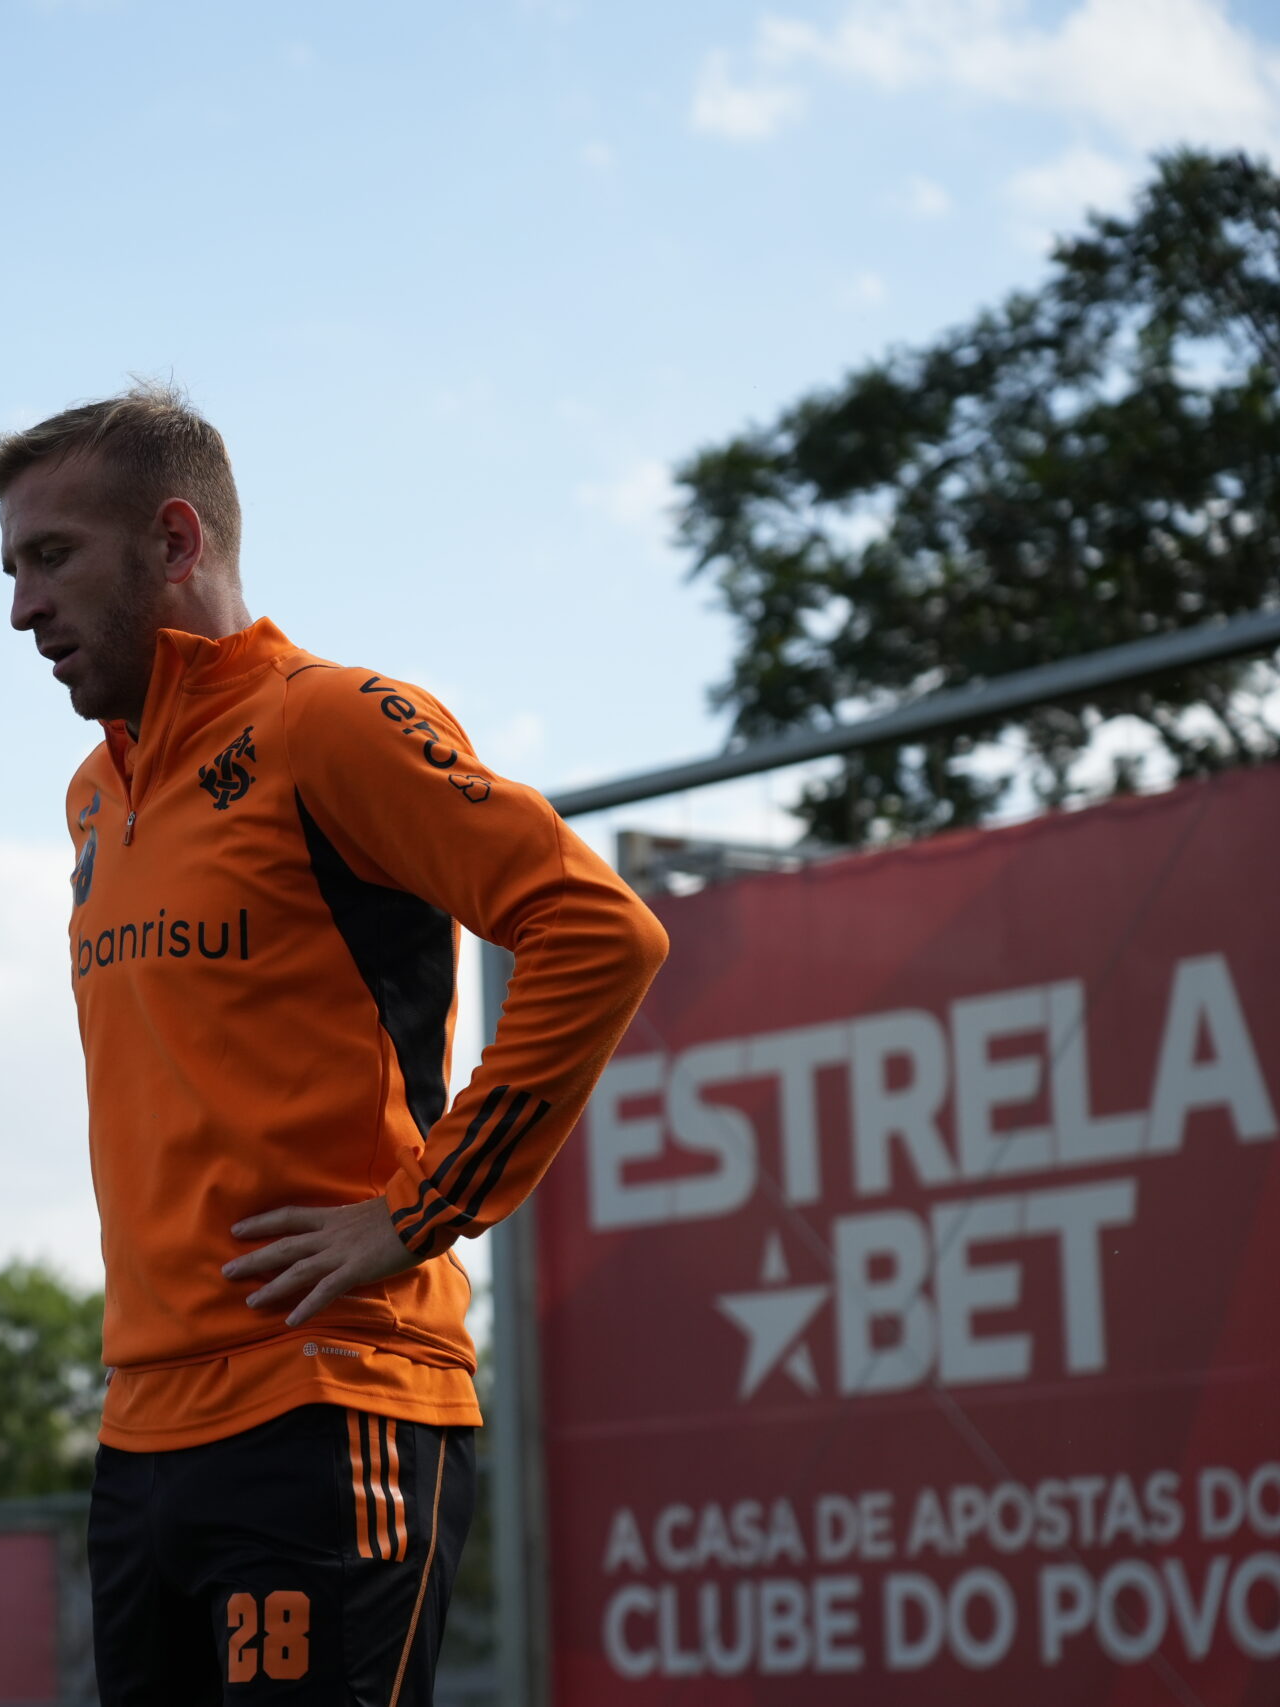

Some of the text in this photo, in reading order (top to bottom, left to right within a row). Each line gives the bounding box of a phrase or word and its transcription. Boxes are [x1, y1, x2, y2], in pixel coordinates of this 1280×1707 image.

[77, 908, 249, 979] banrisul
[585, 952, 1277, 1230] ESTRELA
[833, 1178, 1137, 1397] BET
[605, 1511, 645, 1572] A
[655, 1500, 806, 1571] CASA
[818, 1493, 896, 1563] DE
[908, 1472, 1183, 1553] APOSTAS
[227, 1590, 310, 1683] 28
[603, 1552, 1280, 1678] CLUBE DO POVO
